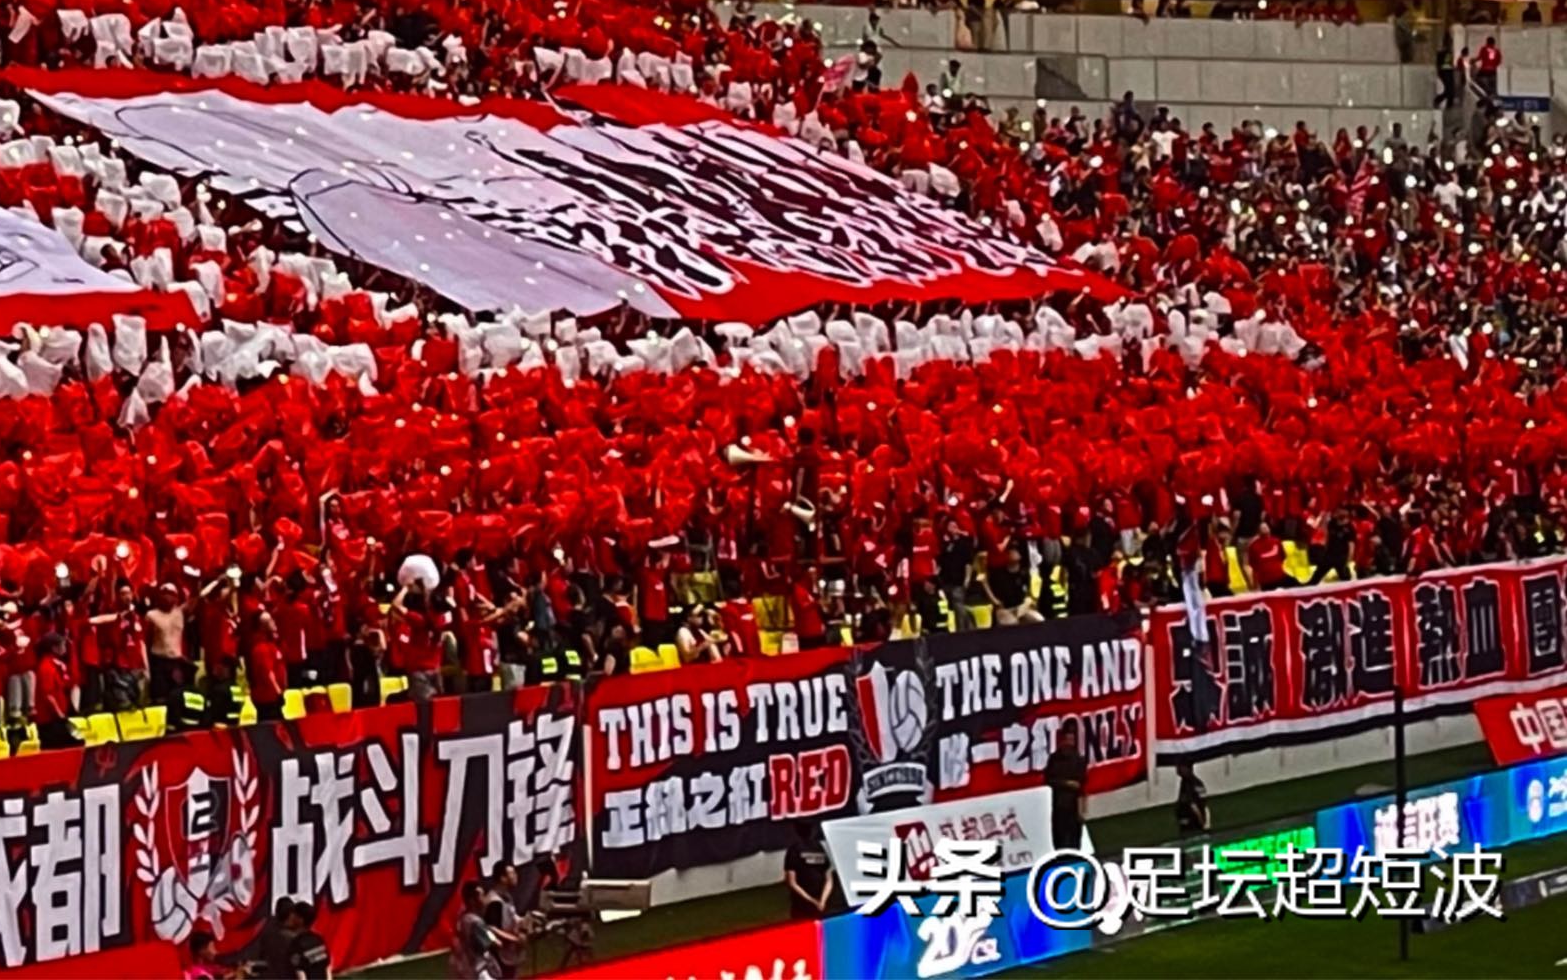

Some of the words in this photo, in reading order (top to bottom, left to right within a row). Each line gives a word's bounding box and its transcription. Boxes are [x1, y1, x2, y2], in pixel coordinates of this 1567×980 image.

[935, 652, 1002, 721] THE
[1011, 642, 1073, 708] ONE
[1079, 637, 1143, 699] AND
[599, 698, 695, 771] THIS
[701, 689, 740, 750] IS
[746, 673, 849, 750] TRUE
[1509, 698, 1567, 755] 中国
[268, 710, 576, 907] 战斗刀锋
[768, 743, 851, 821] RED
